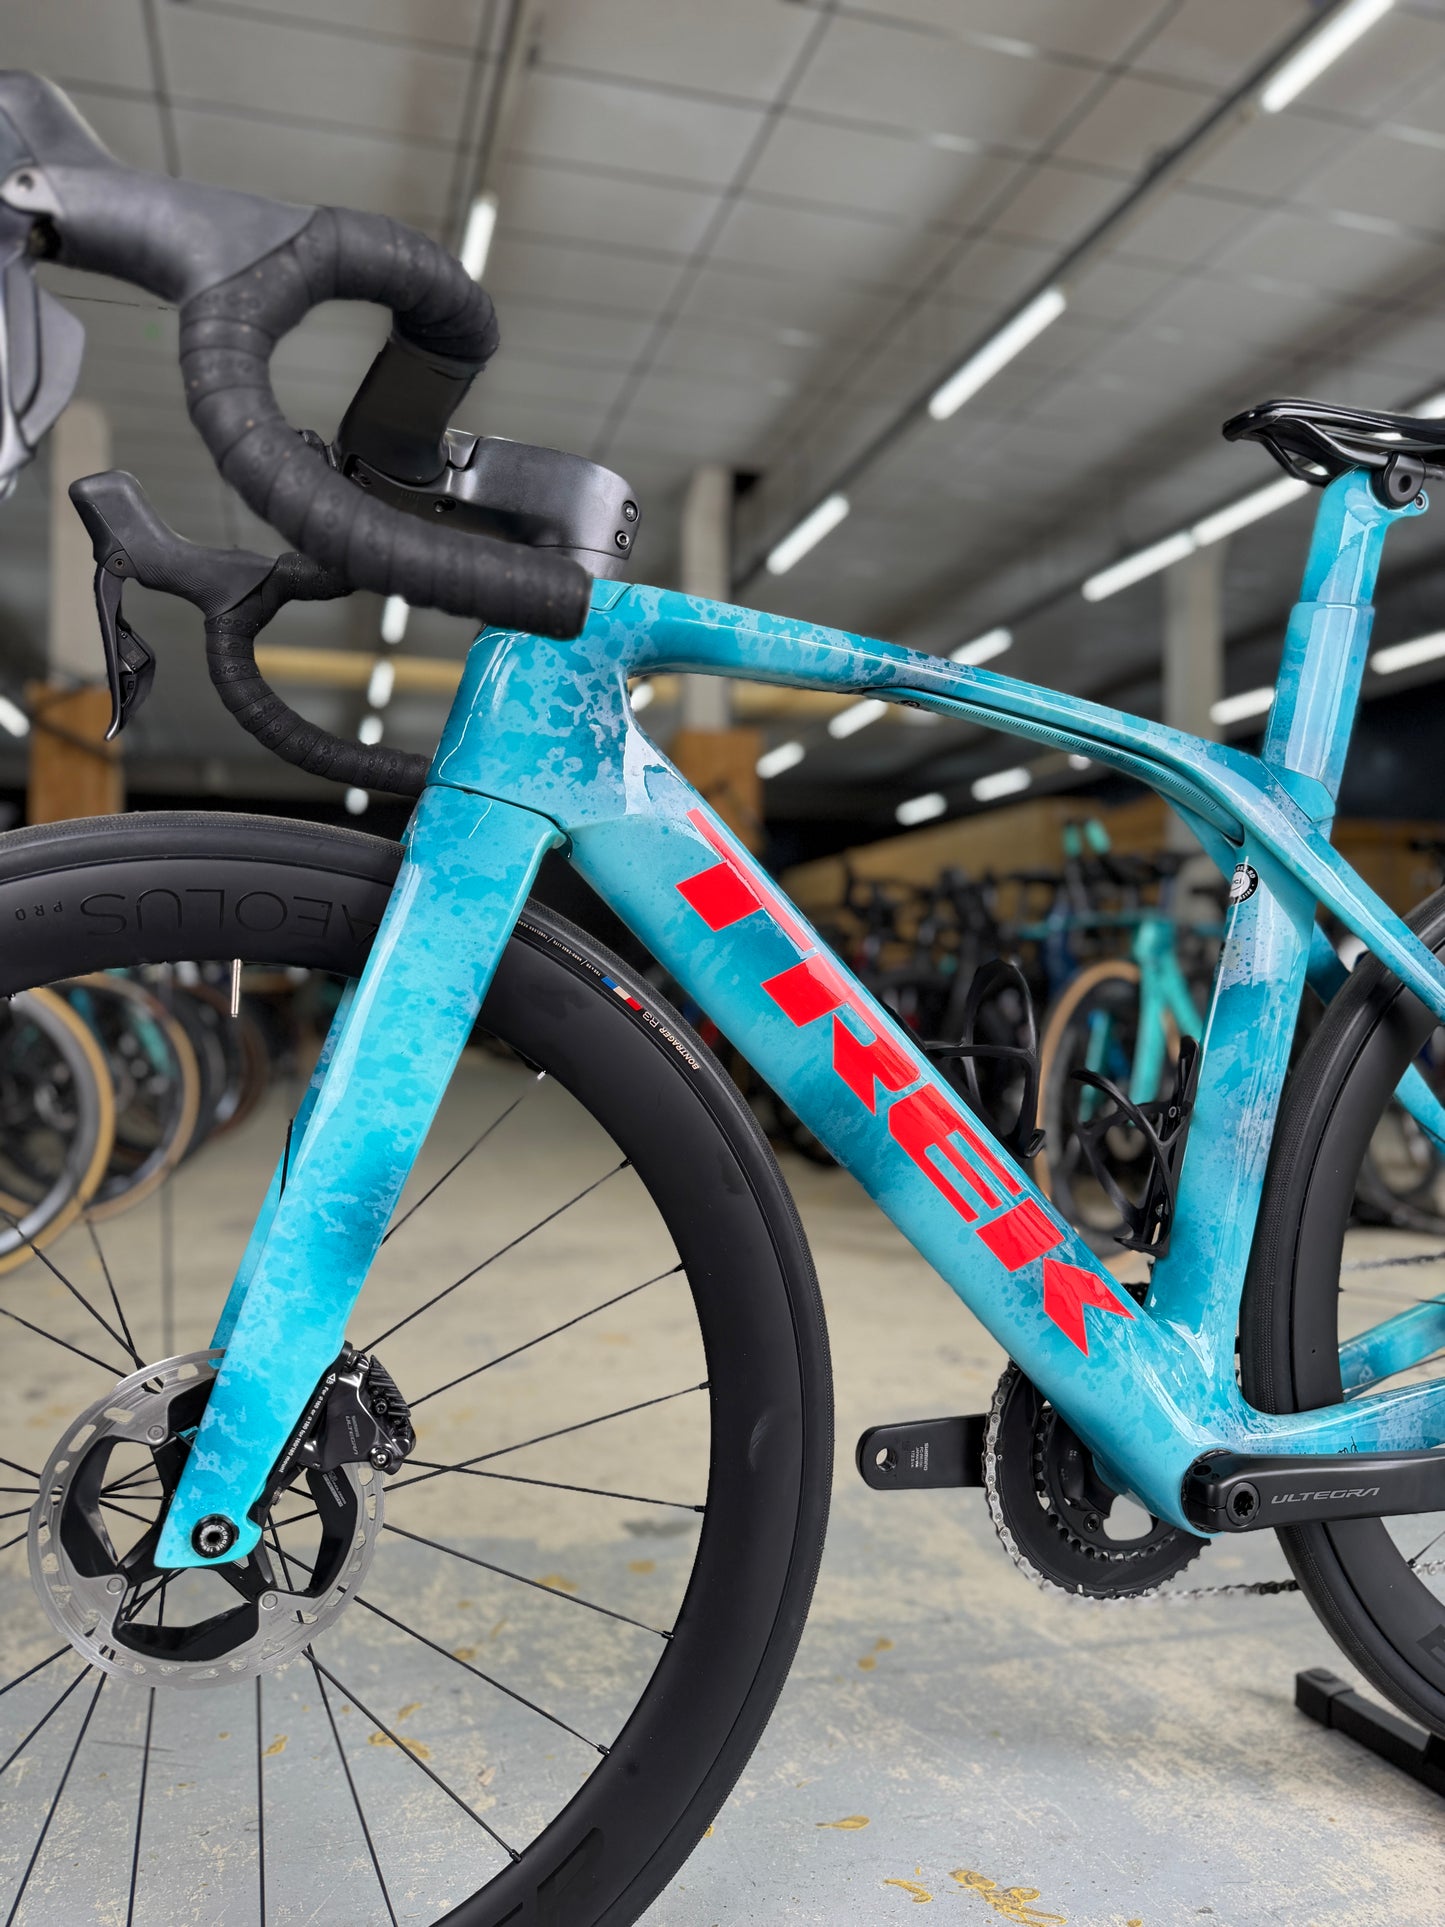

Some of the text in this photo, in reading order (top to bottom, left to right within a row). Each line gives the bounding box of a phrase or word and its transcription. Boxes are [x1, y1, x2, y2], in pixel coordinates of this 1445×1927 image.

[15, 888, 380, 947] AEOLUS PRO
[642, 1010, 700, 1070] BONTRAGER R3
[676, 808, 1136, 1357] TREK
[279, 1456, 291, 1473] mount
[1271, 1487, 1380, 1504] ULTEGRA
